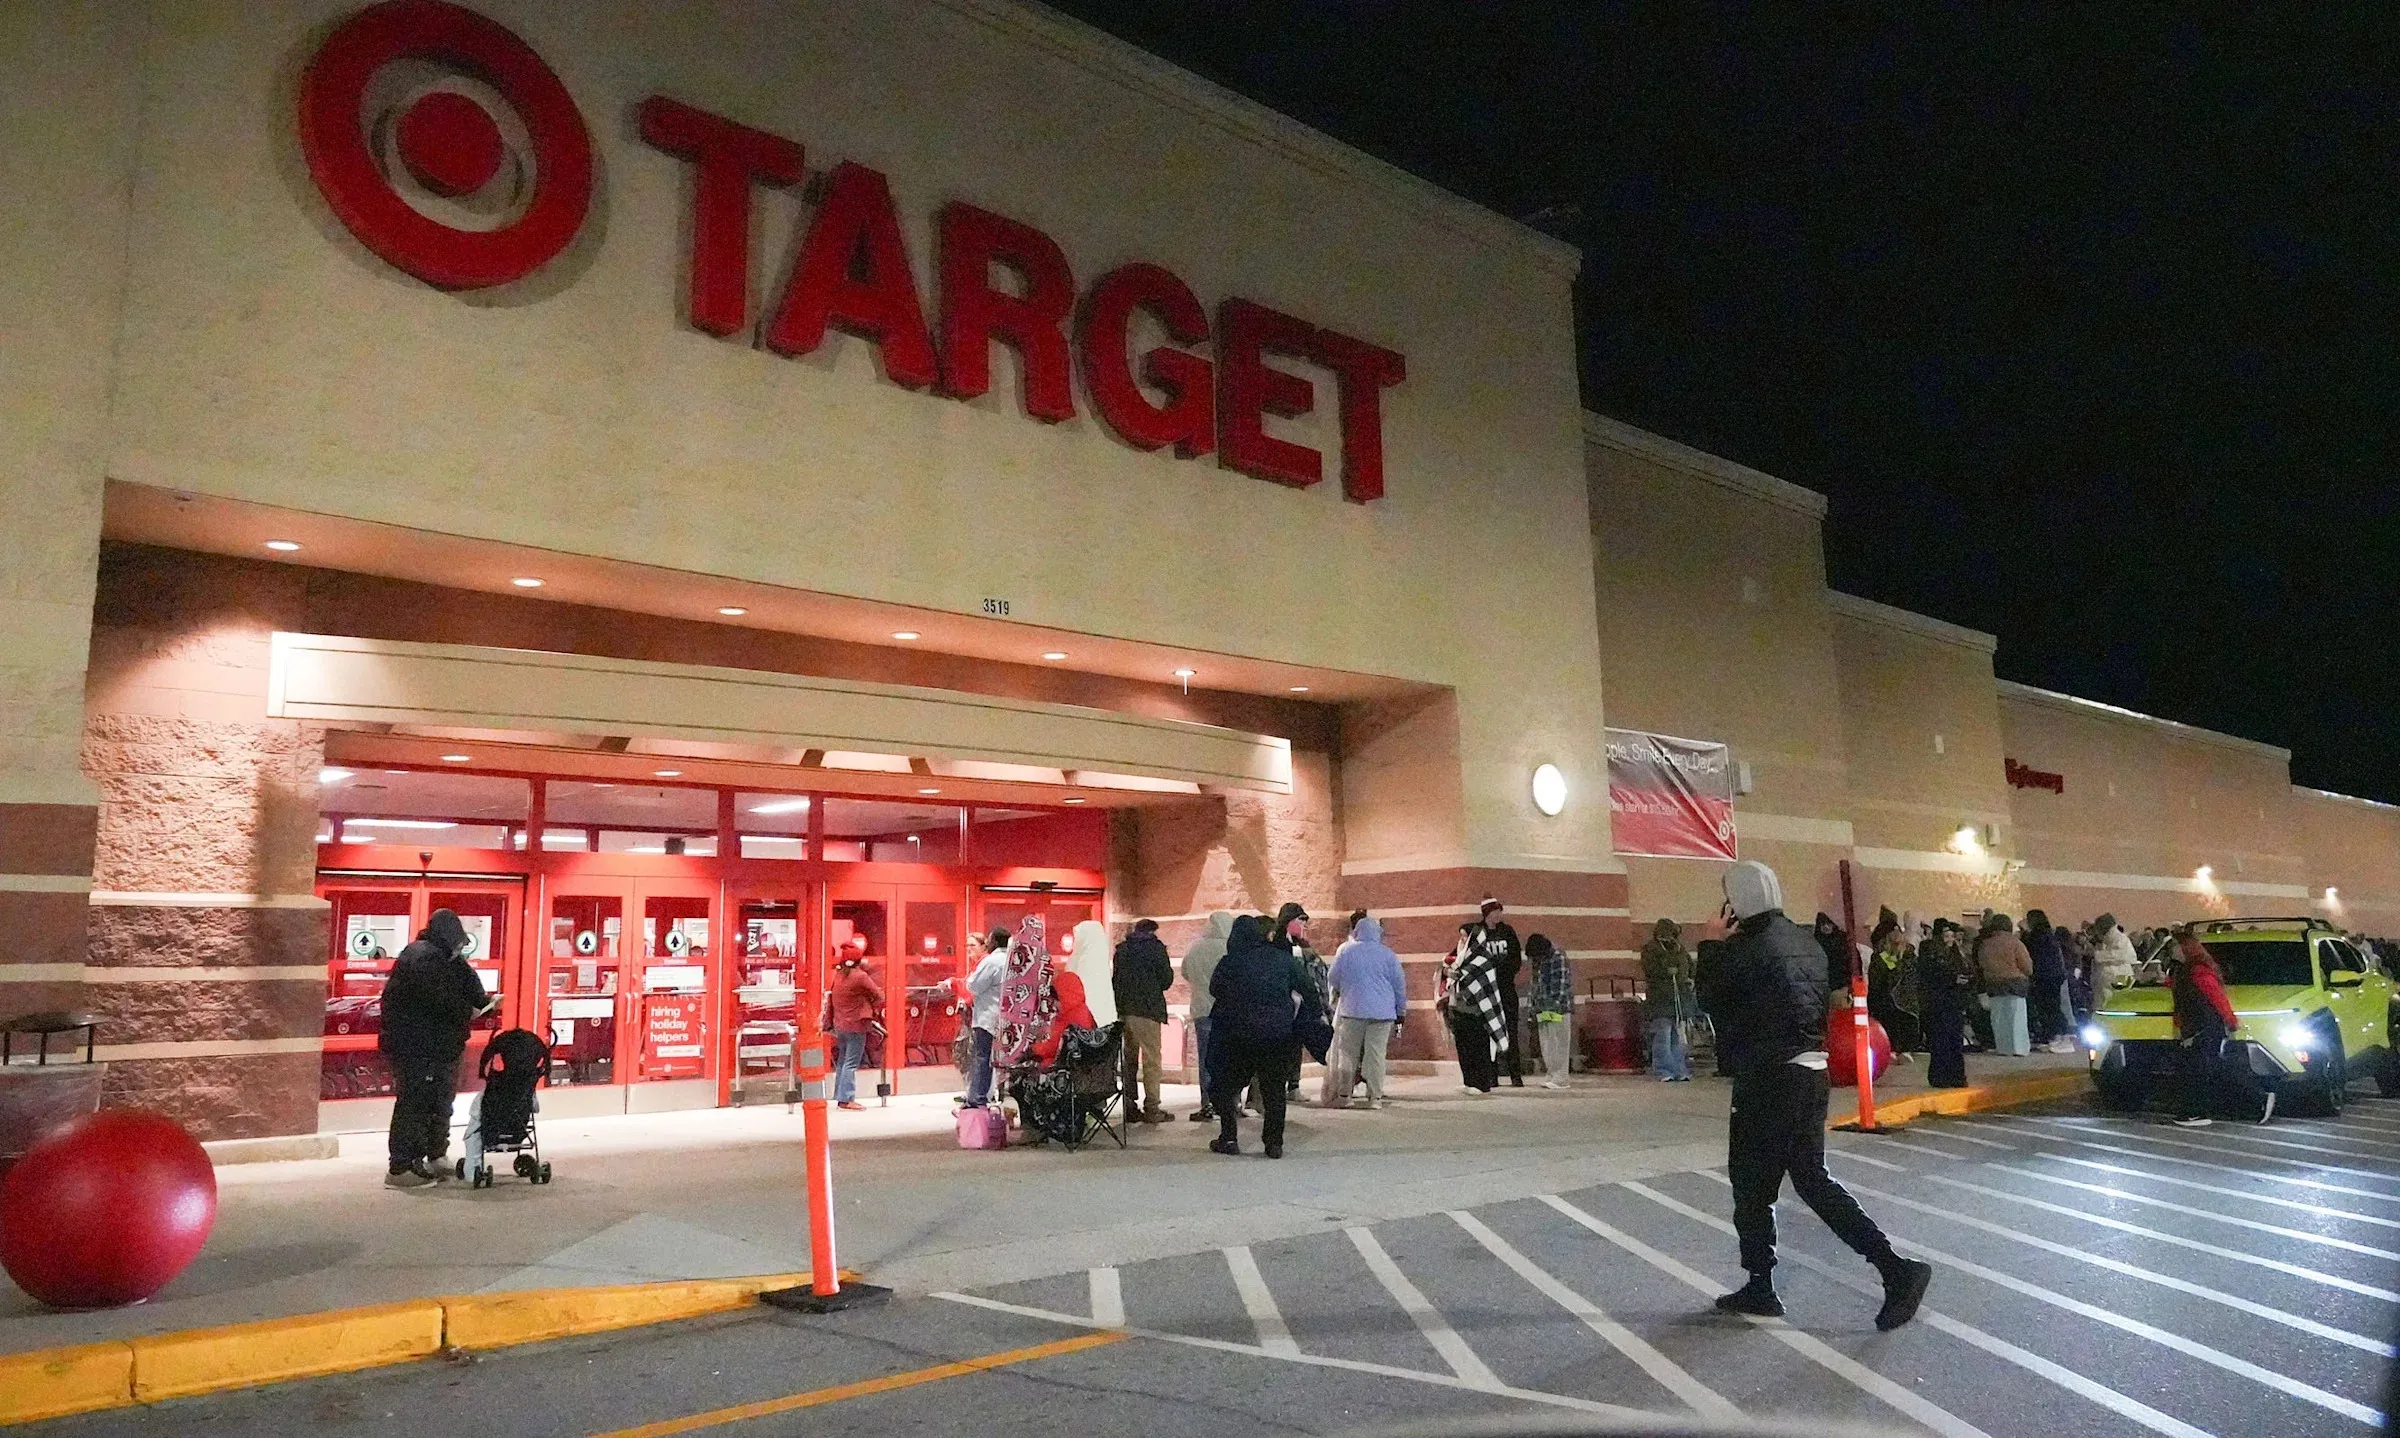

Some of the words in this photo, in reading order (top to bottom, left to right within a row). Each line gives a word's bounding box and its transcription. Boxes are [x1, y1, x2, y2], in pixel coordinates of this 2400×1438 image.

[638, 95, 1405, 504] TARGET
[983, 598, 1010, 615] 3519
[651, 1006, 681, 1018] hiring
[650, 1019, 688, 1031] holiday
[650, 1031, 689, 1043] helpers
